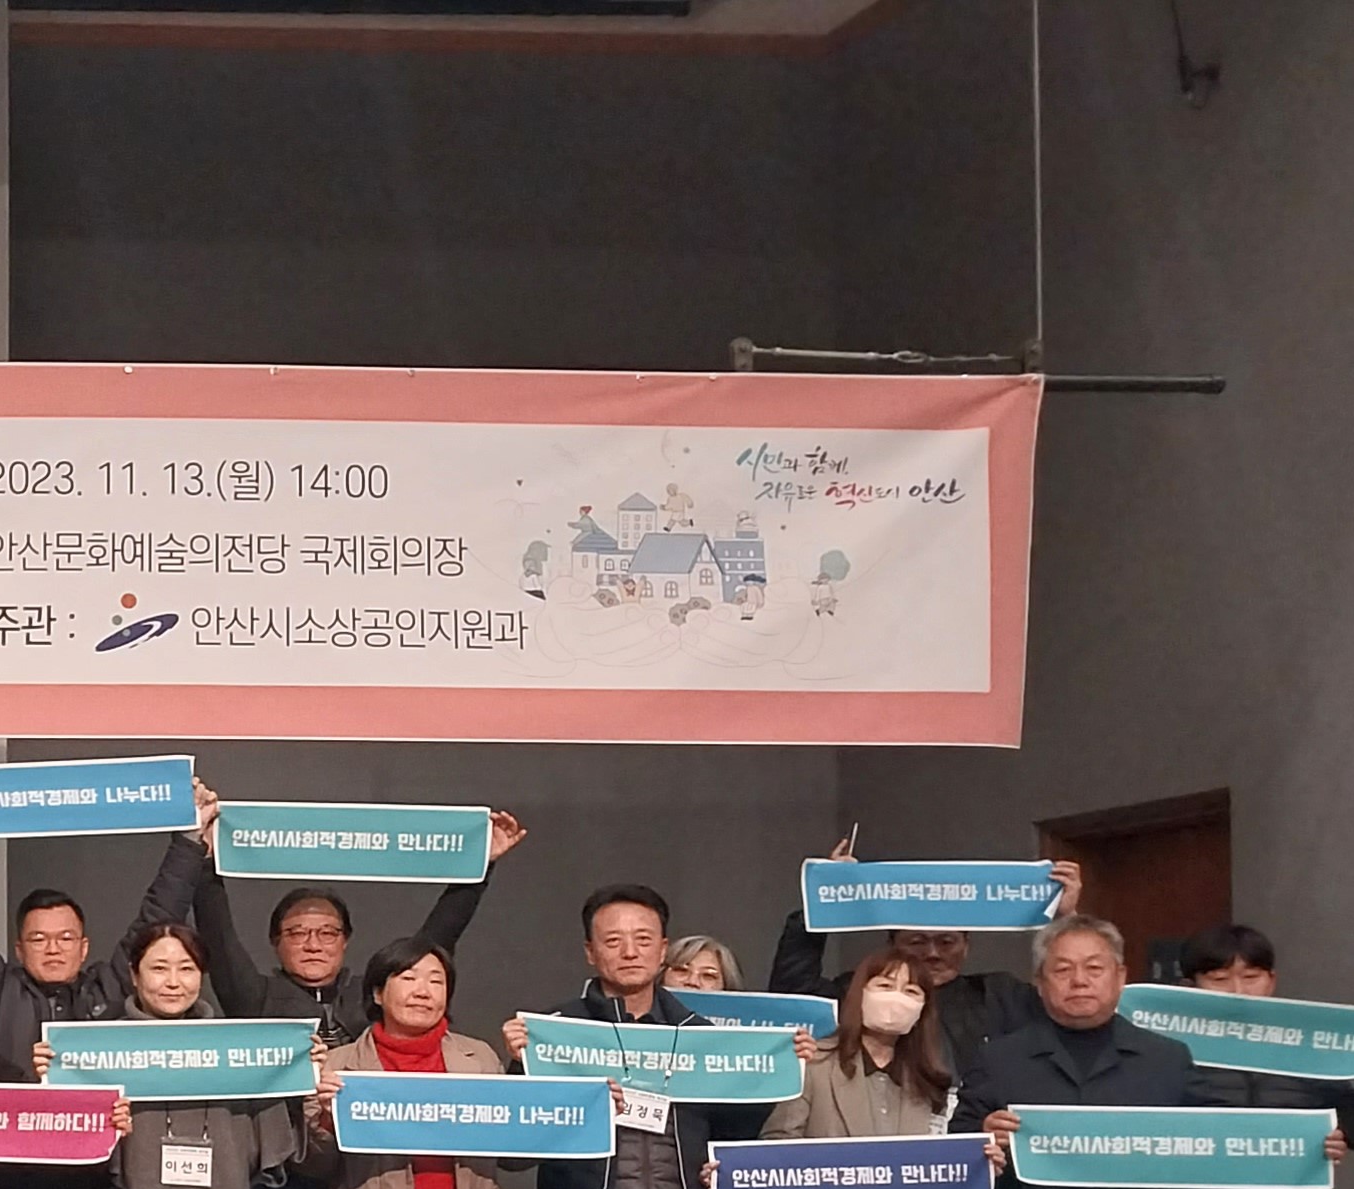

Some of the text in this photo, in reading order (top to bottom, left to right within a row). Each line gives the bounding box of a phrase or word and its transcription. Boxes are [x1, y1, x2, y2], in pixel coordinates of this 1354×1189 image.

[736, 442, 801, 481] 시민과
[99, 463, 148, 498] 11.
[164, 461, 275, 503] 13.(월)
[291, 465, 389, 500] 14:00
[755, 478, 965, 512] 자유로운 혁신도시 안산
[300, 536, 469, 578] 국제회의장
[192, 607, 530, 651] 안산시소상공인지원과
[106, 784, 173, 805] 나누다!!
[233, 830, 465, 853] 안산시사회적경제와 만나다!!
[819, 883, 1053, 904] 안산시사회적경제와 나누다!!
[1132, 1010, 1305, 1048] 안산시사회적경제와
[61, 1047, 295, 1071] 안산시사회적경제와 만나다!!
[536, 1044, 776, 1077] 안산시사회적경제와 만나다!!
[18, 1113, 106, 1134] 함께하다!!
[351, 1102, 586, 1127] 안산시사회적경제와 나누다!!
[1030, 1136, 1306, 1158] 안산시사회적경제와 만나다!!
[733, 1164, 969, 1189] 안산시사회적경제와 만나다!!
